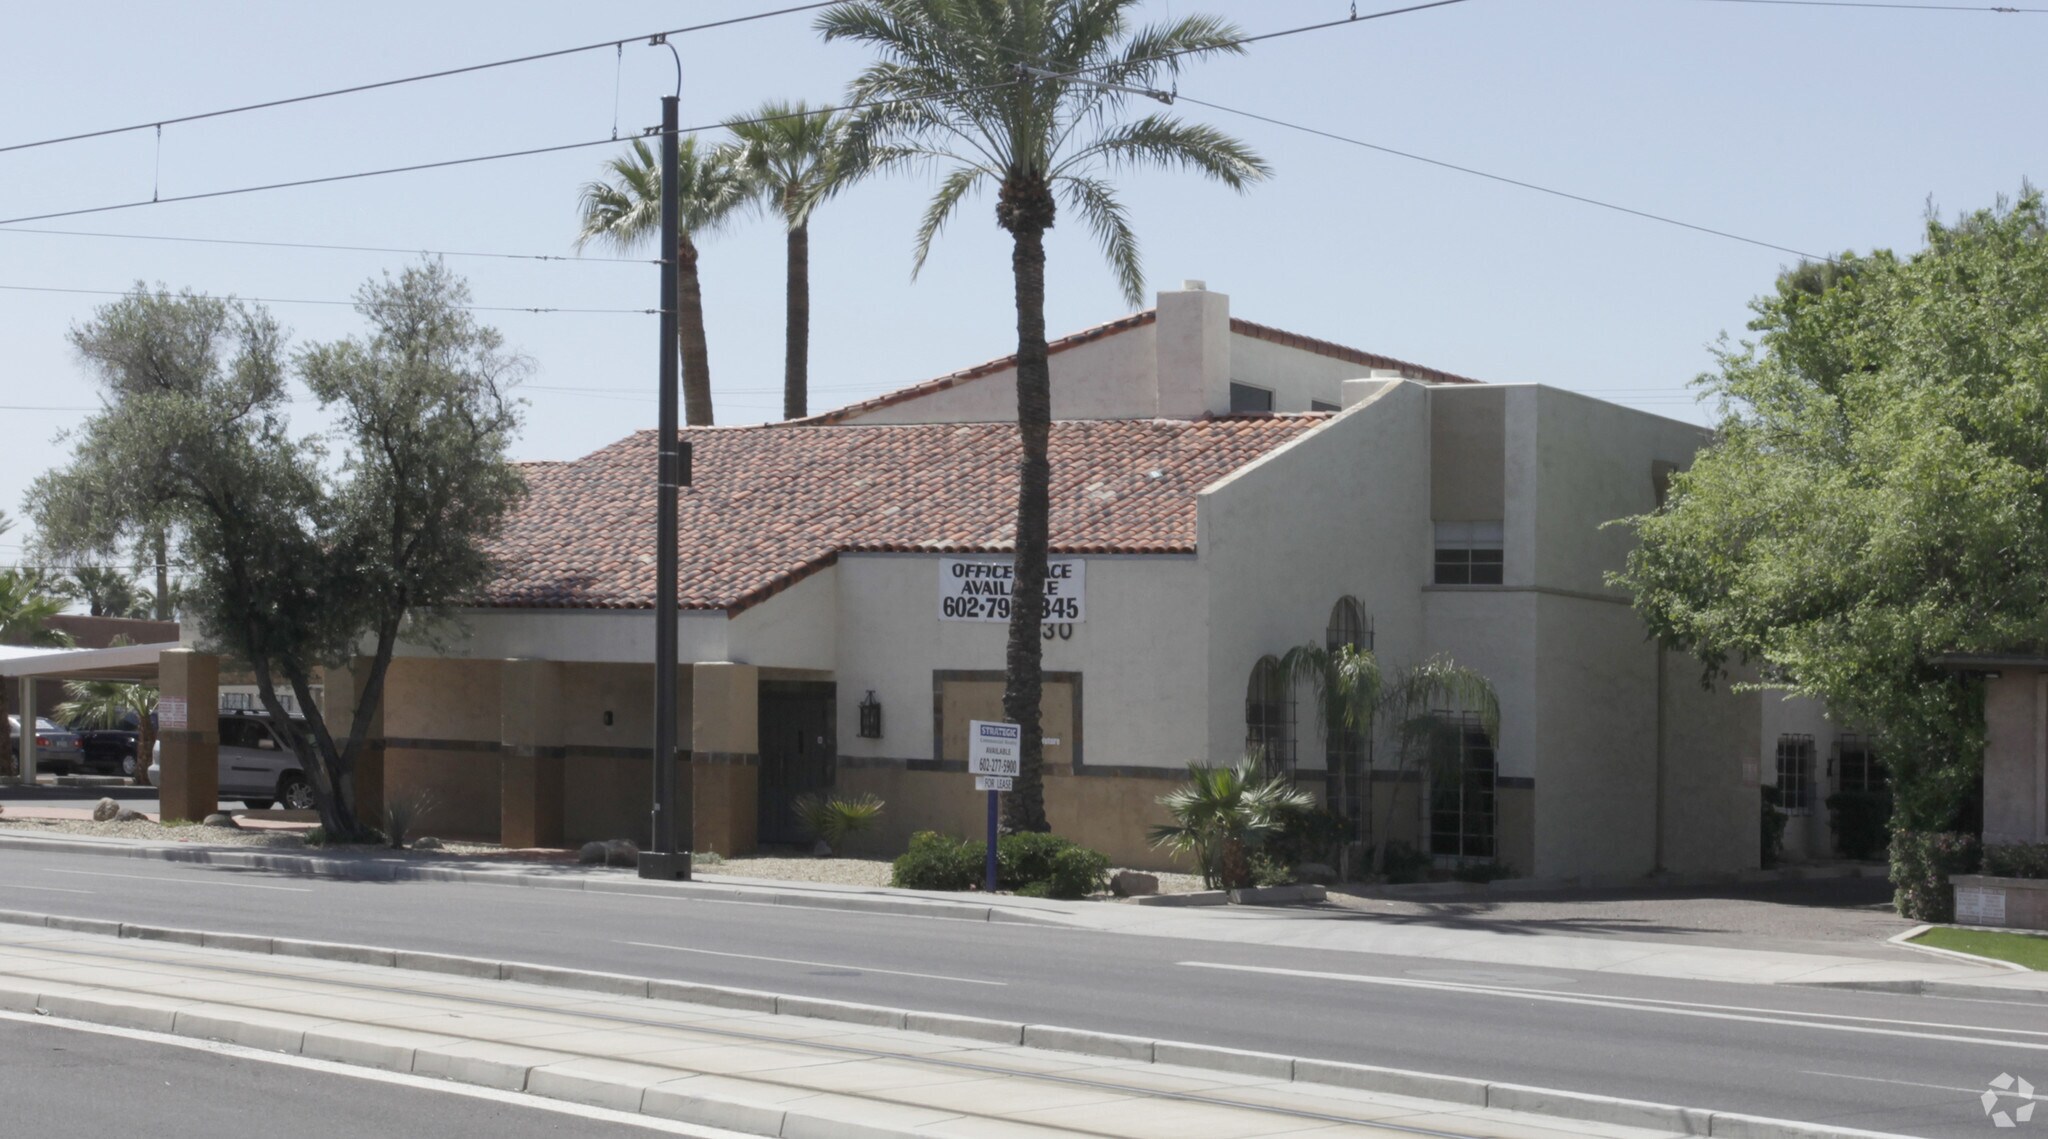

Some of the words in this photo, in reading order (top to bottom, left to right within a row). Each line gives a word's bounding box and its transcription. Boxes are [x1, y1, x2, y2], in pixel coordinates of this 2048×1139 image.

[952, 563, 1013, 578] OFFICE
[961, 581, 1059, 595] AVAILE
[981, 726, 1017, 737] STRATEGIC
[986, 747, 1011, 756] AVAILABLE
[979, 758, 1017, 774] 602-277-5900
[984, 778, 995, 788] FOR
[997, 778, 1012, 790] LEASE
